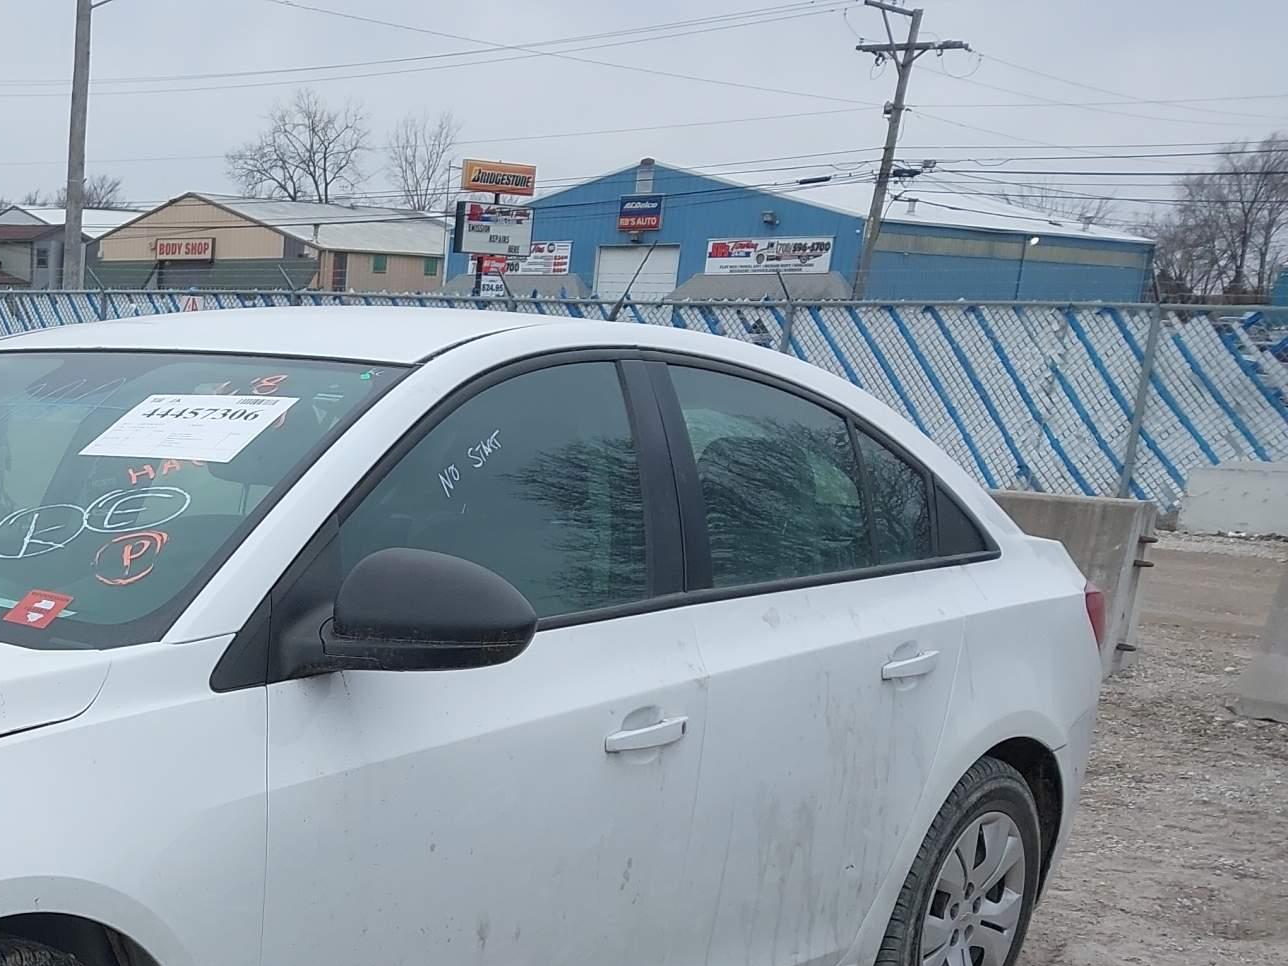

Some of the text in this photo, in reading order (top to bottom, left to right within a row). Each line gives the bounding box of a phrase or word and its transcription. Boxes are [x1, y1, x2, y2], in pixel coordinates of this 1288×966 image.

[472, 169, 532, 187] BRIDGESTONE
[636, 217, 658, 226] AUTO
[159, 242, 209, 255] BODY SHOP
[143, 407, 265, 421] 44457306
